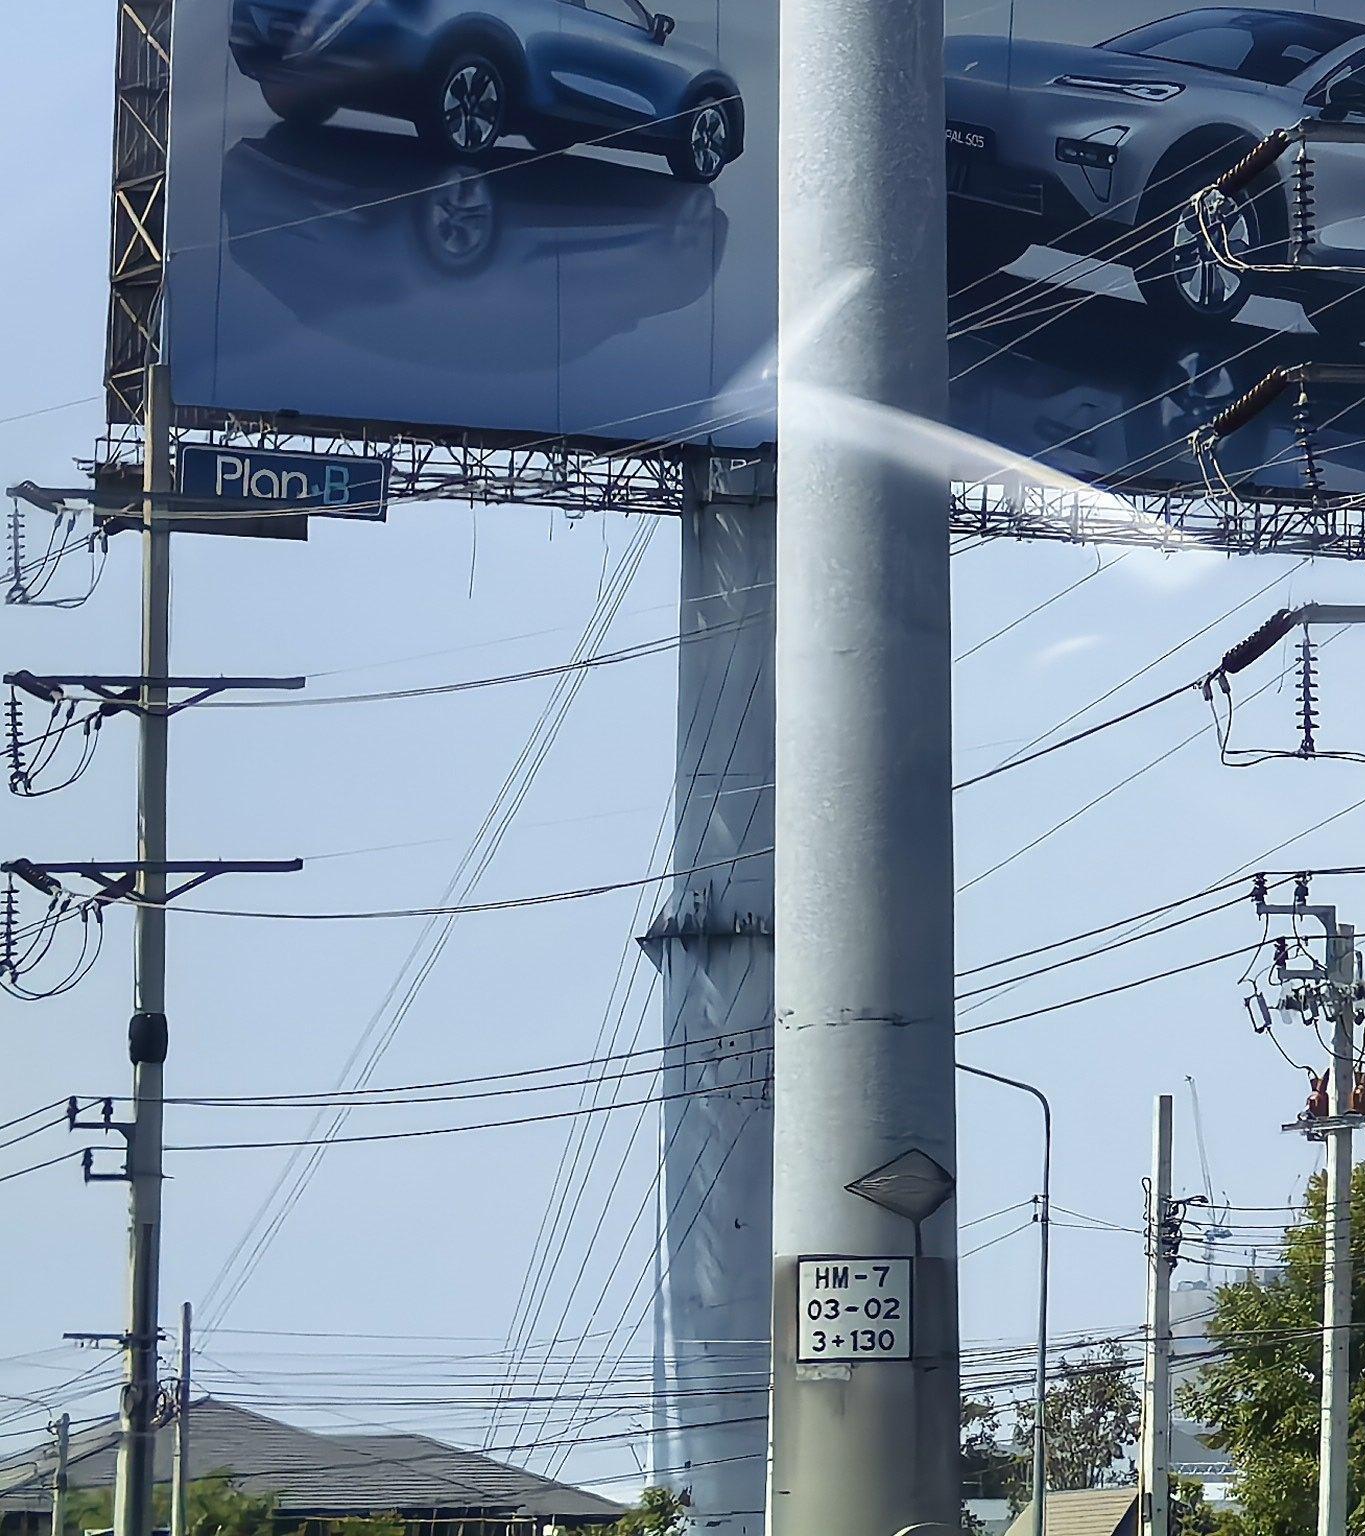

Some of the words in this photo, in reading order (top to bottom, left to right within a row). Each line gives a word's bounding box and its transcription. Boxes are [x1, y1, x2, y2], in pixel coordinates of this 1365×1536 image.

[215, 454, 308, 499] Plan
[323, 465, 350, 505] B
[815, 1266, 890, 1290] HM-7
[807, 1297, 901, 1321] 03-02
[811, 1328, 895, 1352] 3+130
